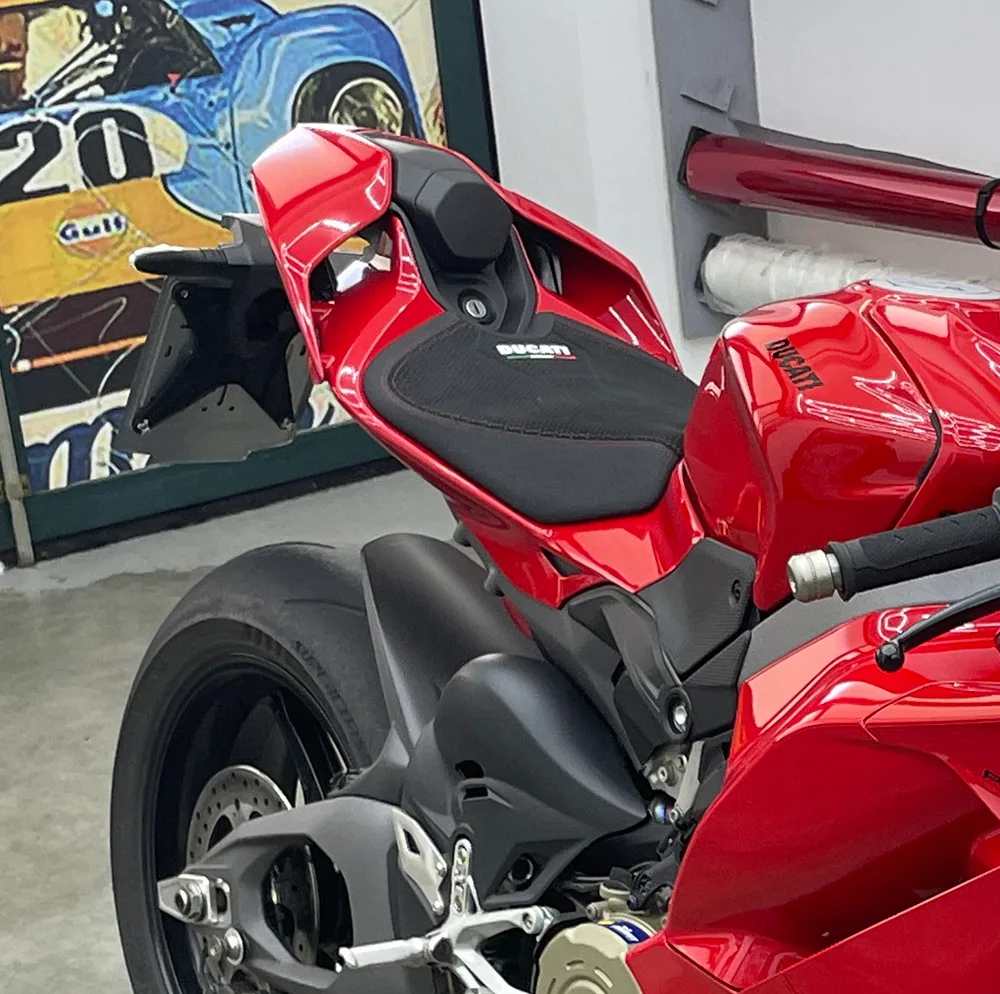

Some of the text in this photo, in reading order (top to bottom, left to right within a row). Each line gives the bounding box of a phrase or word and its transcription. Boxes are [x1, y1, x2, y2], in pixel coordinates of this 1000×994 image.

[0, 109, 154, 206] 20
[59, 216, 124, 241] Gulf
[496, 344, 571, 355] DUCATI
[765, 338, 824, 391] DUCATI
